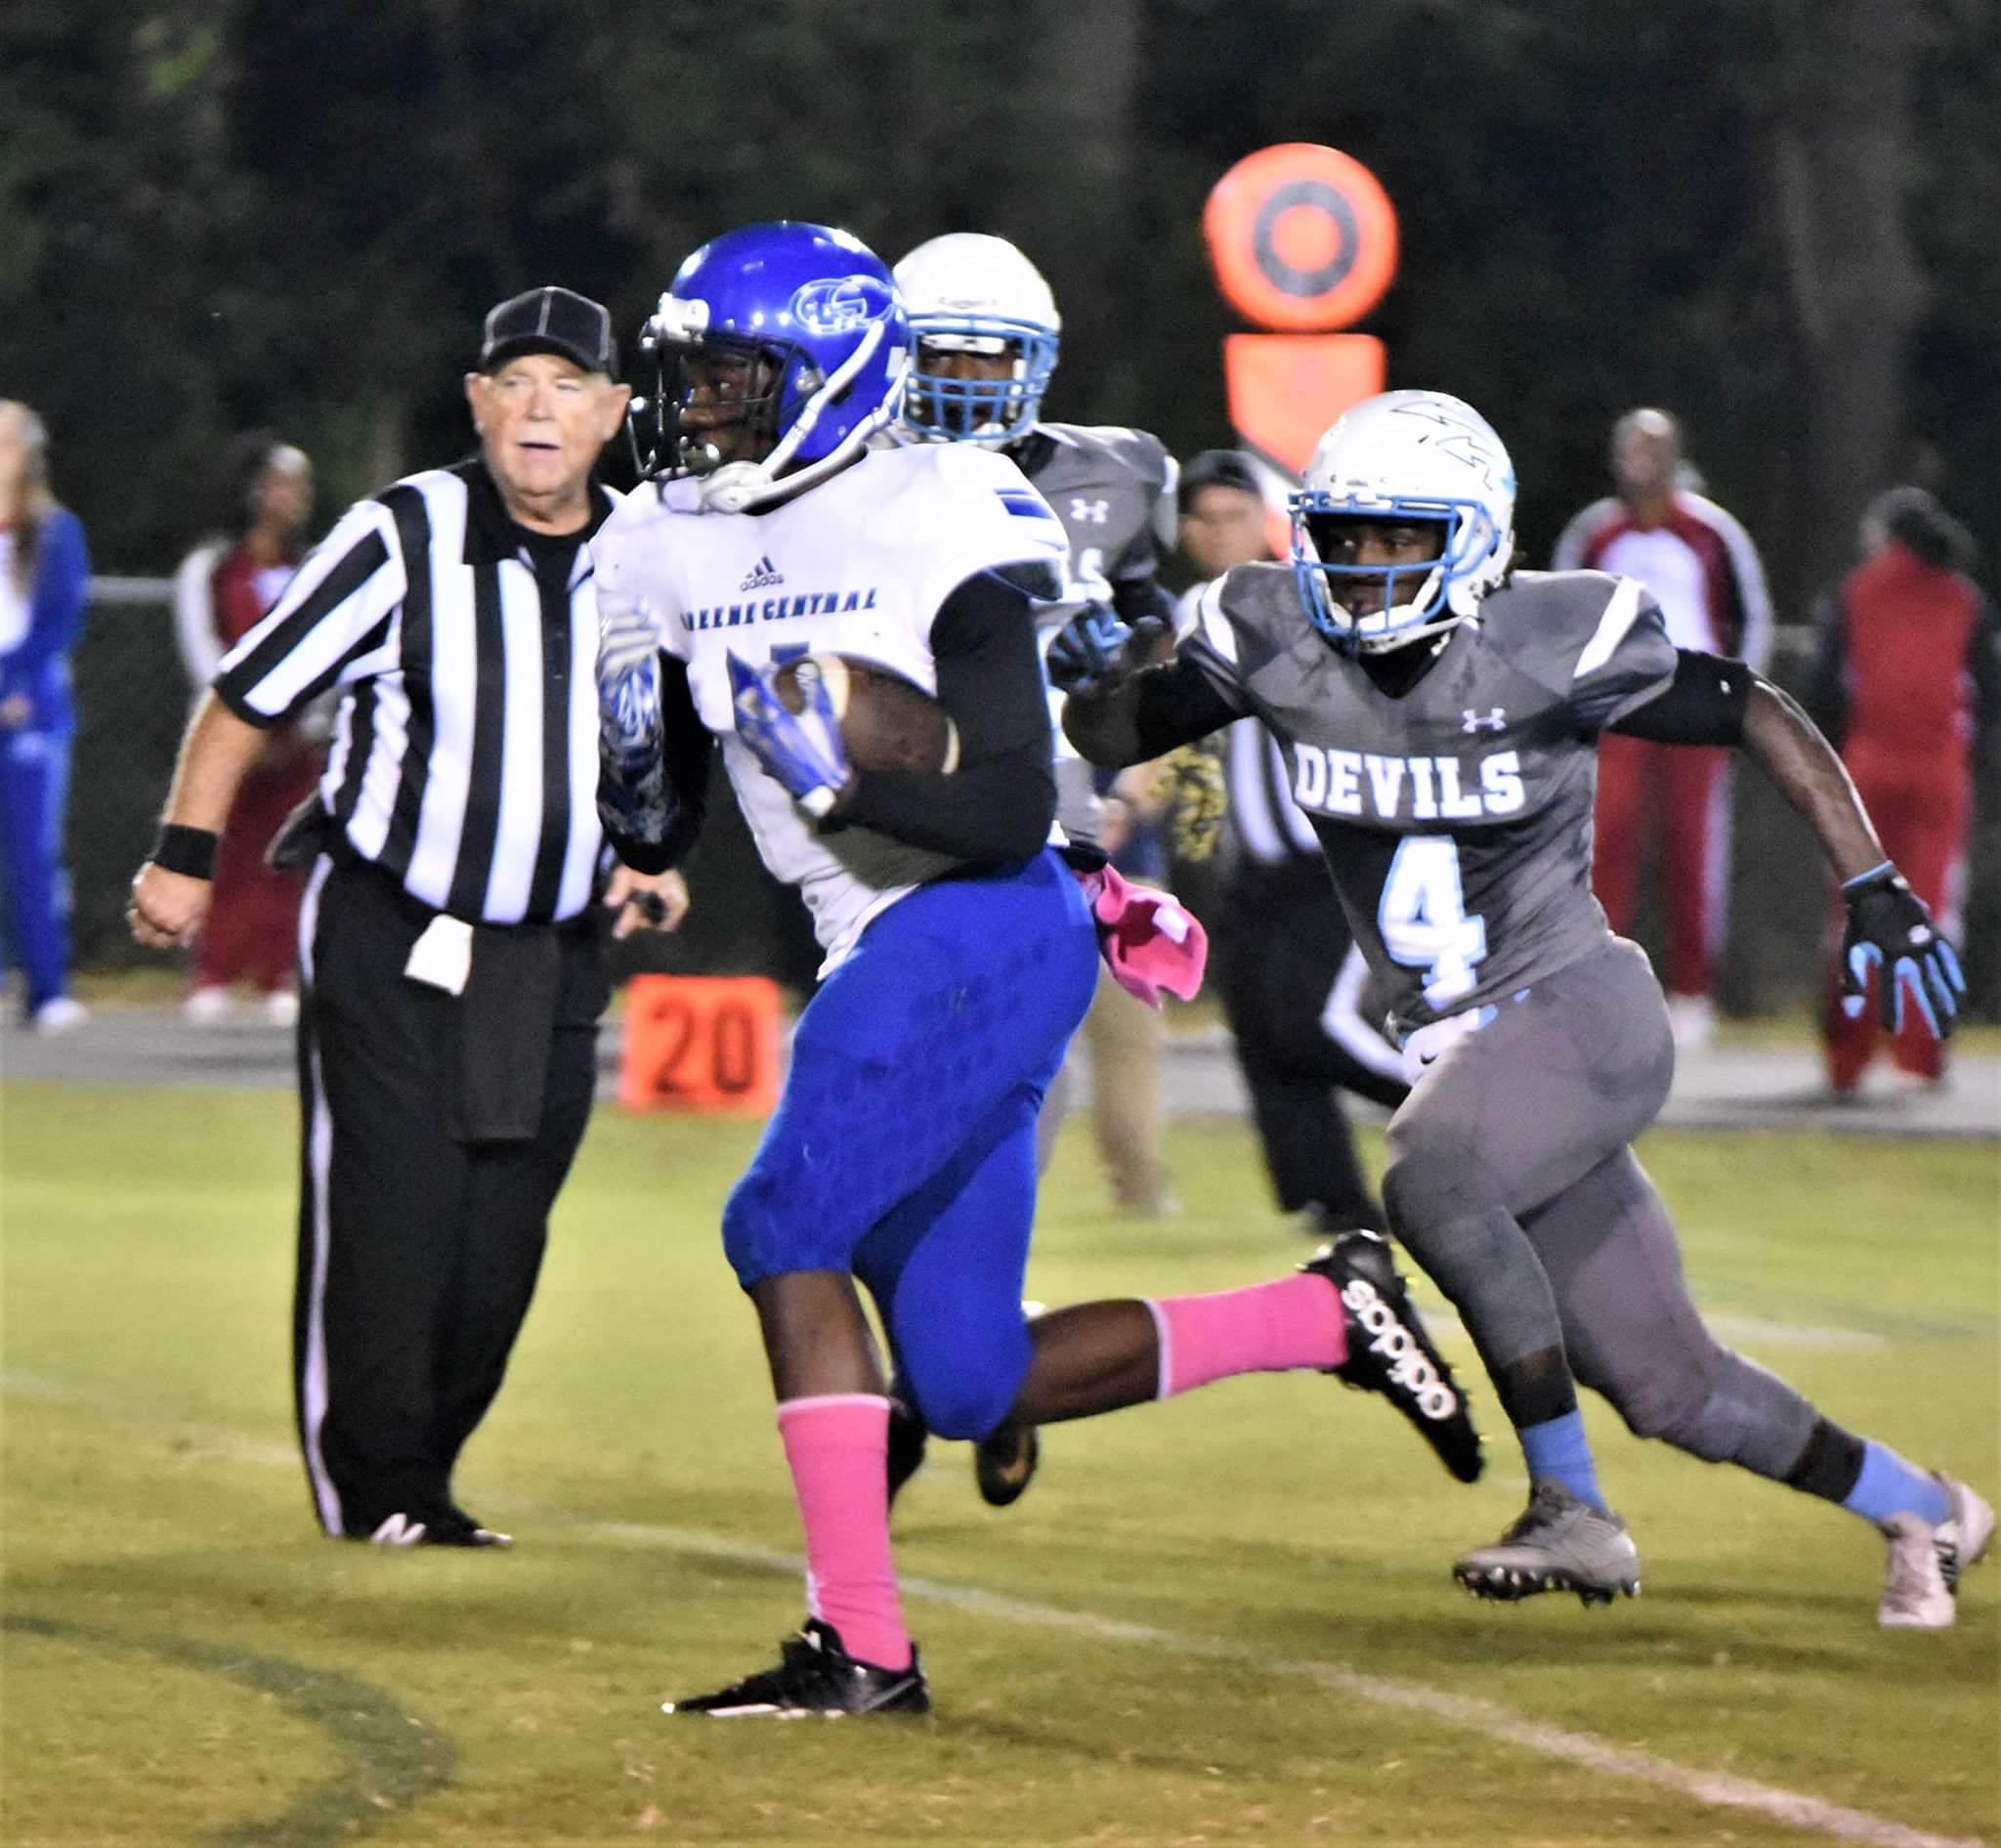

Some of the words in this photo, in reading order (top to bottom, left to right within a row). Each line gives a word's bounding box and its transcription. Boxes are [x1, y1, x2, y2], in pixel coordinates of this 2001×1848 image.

[740, 573, 785, 592] adidas
[762, 587, 877, 621] CENTRAL
[1292, 742, 1525, 820] DEVILS
[1376, 834, 1488, 1012] 4
[651, 996, 754, 1095] 20
[1341, 1279, 1458, 1421] adidas
